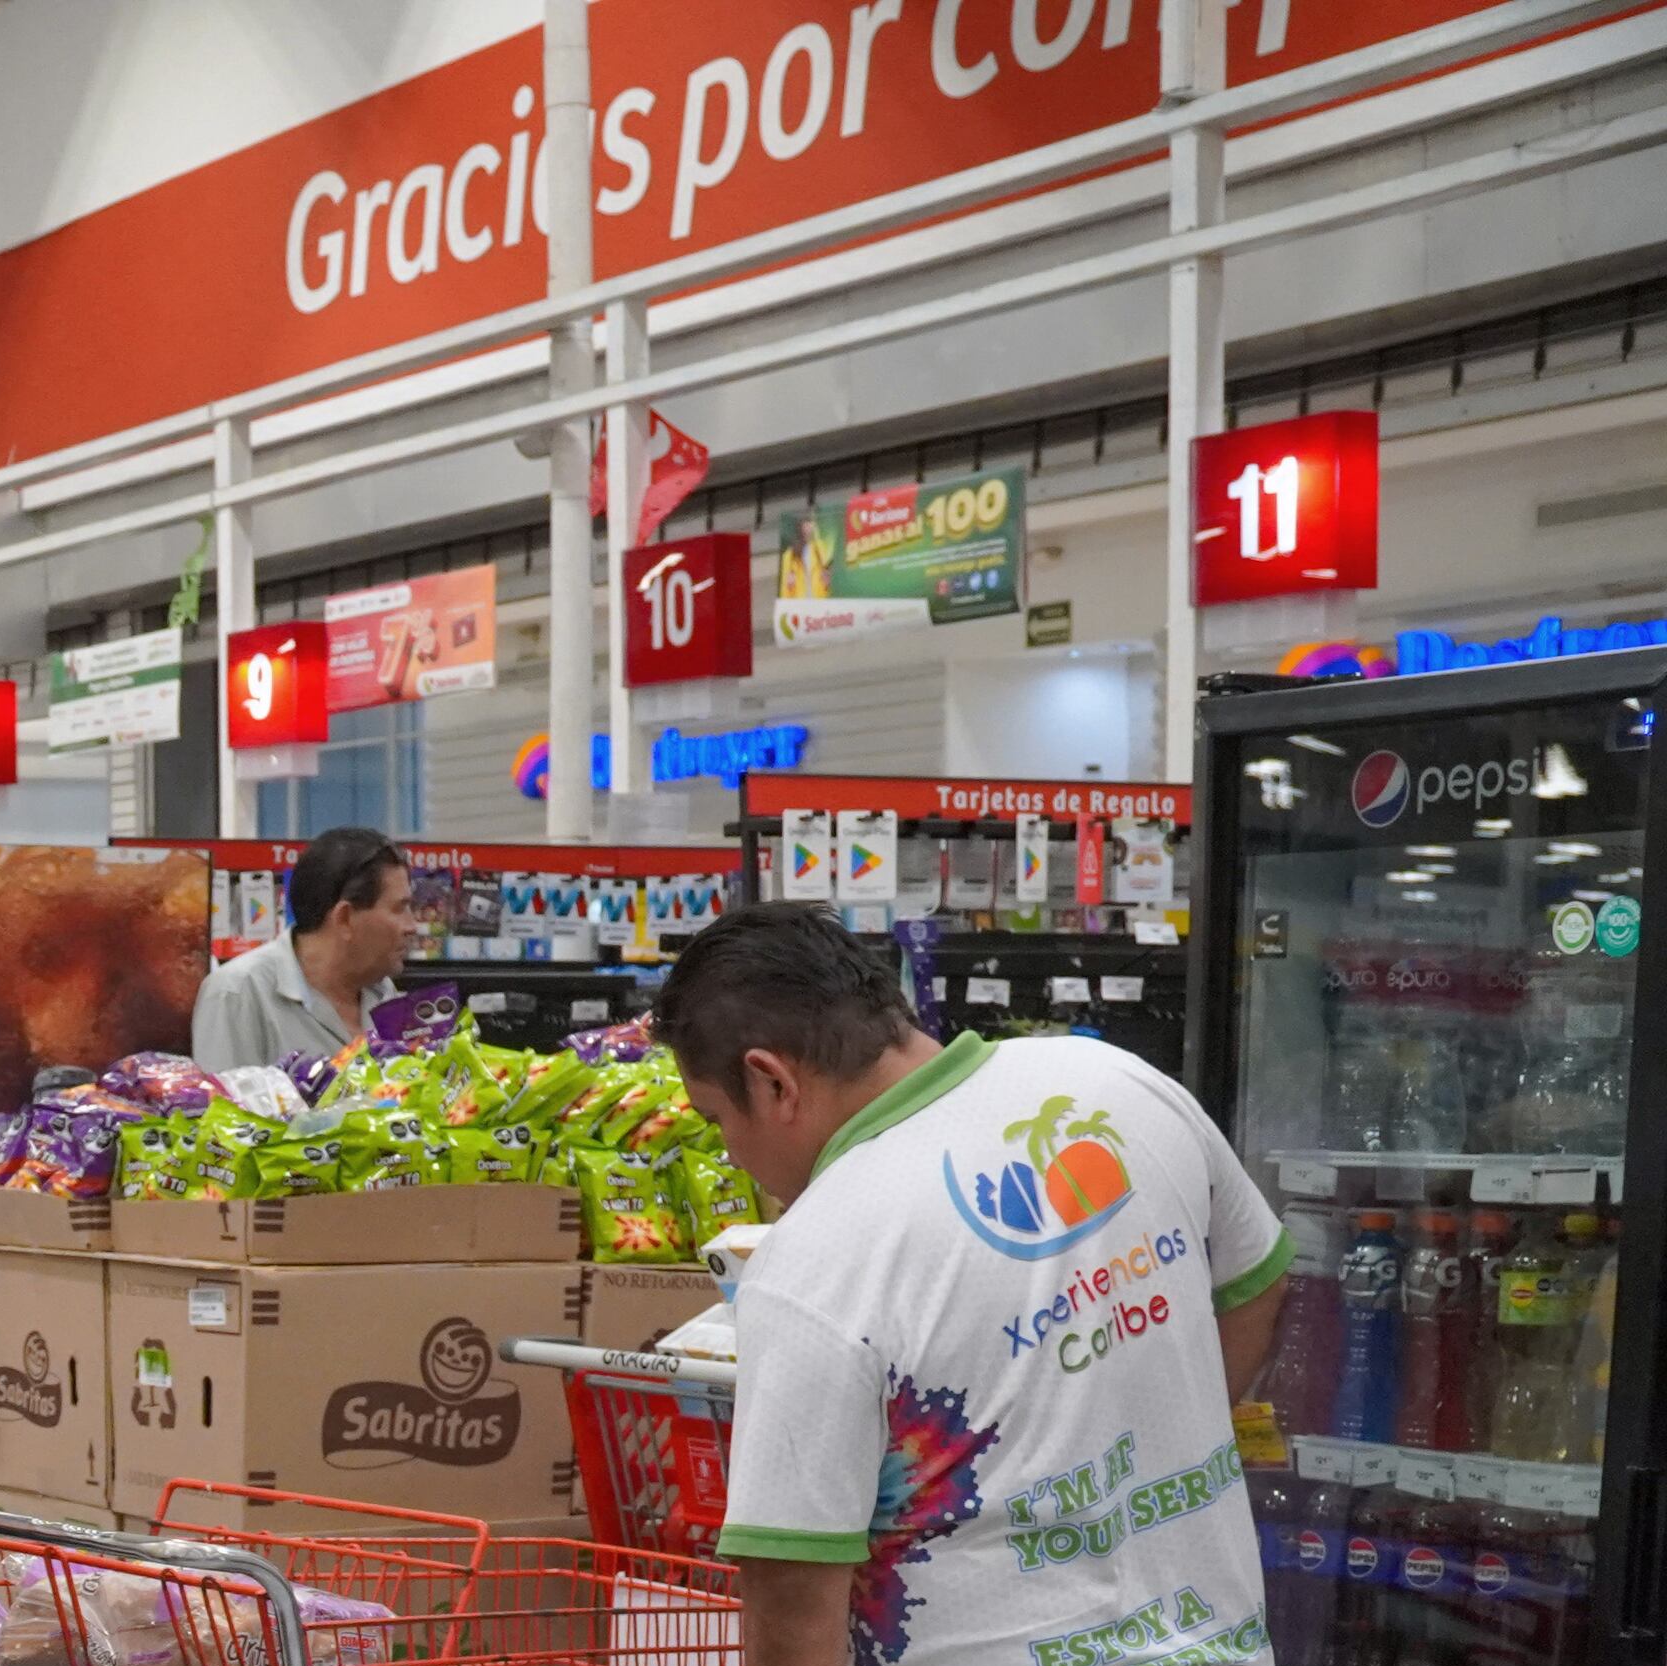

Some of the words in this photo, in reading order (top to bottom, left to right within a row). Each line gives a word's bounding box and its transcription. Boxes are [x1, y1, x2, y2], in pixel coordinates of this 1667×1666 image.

[671, 0, 900, 239] por
[925, 479, 1009, 544] 100
[1227, 456, 1298, 559] 11
[643, 571, 694, 650] 10
[805, 611, 855, 632] Soriana
[378, 609, 437, 685] 7%
[244, 653, 273, 720] 9
[937, 785, 1044, 816] Tarjetas
[1052, 788, 1080, 812] de
[1090, 790, 1176, 820] Regalo
[1417, 746, 1540, 812] pepsi
[272, 845, 298, 865] Ta
[406, 851, 472, 868] egalo
[604, 1272, 627, 1288] NO
[1003, 1228, 1187, 1359] Xperiencias
[1435, 1257, 1463, 1287] G
[603, 1350, 681, 1373] GRACIAS
[1059, 1293, 1170, 1374] Caribe
[0, 1375, 58, 1418] Sabritas
[343, 1397, 503, 1449] Sabritas
[1103, 1431, 1135, 1494] AT
[1406, 1562, 1442, 1575] PEPSI
[1174, 1586, 1215, 1635] A
